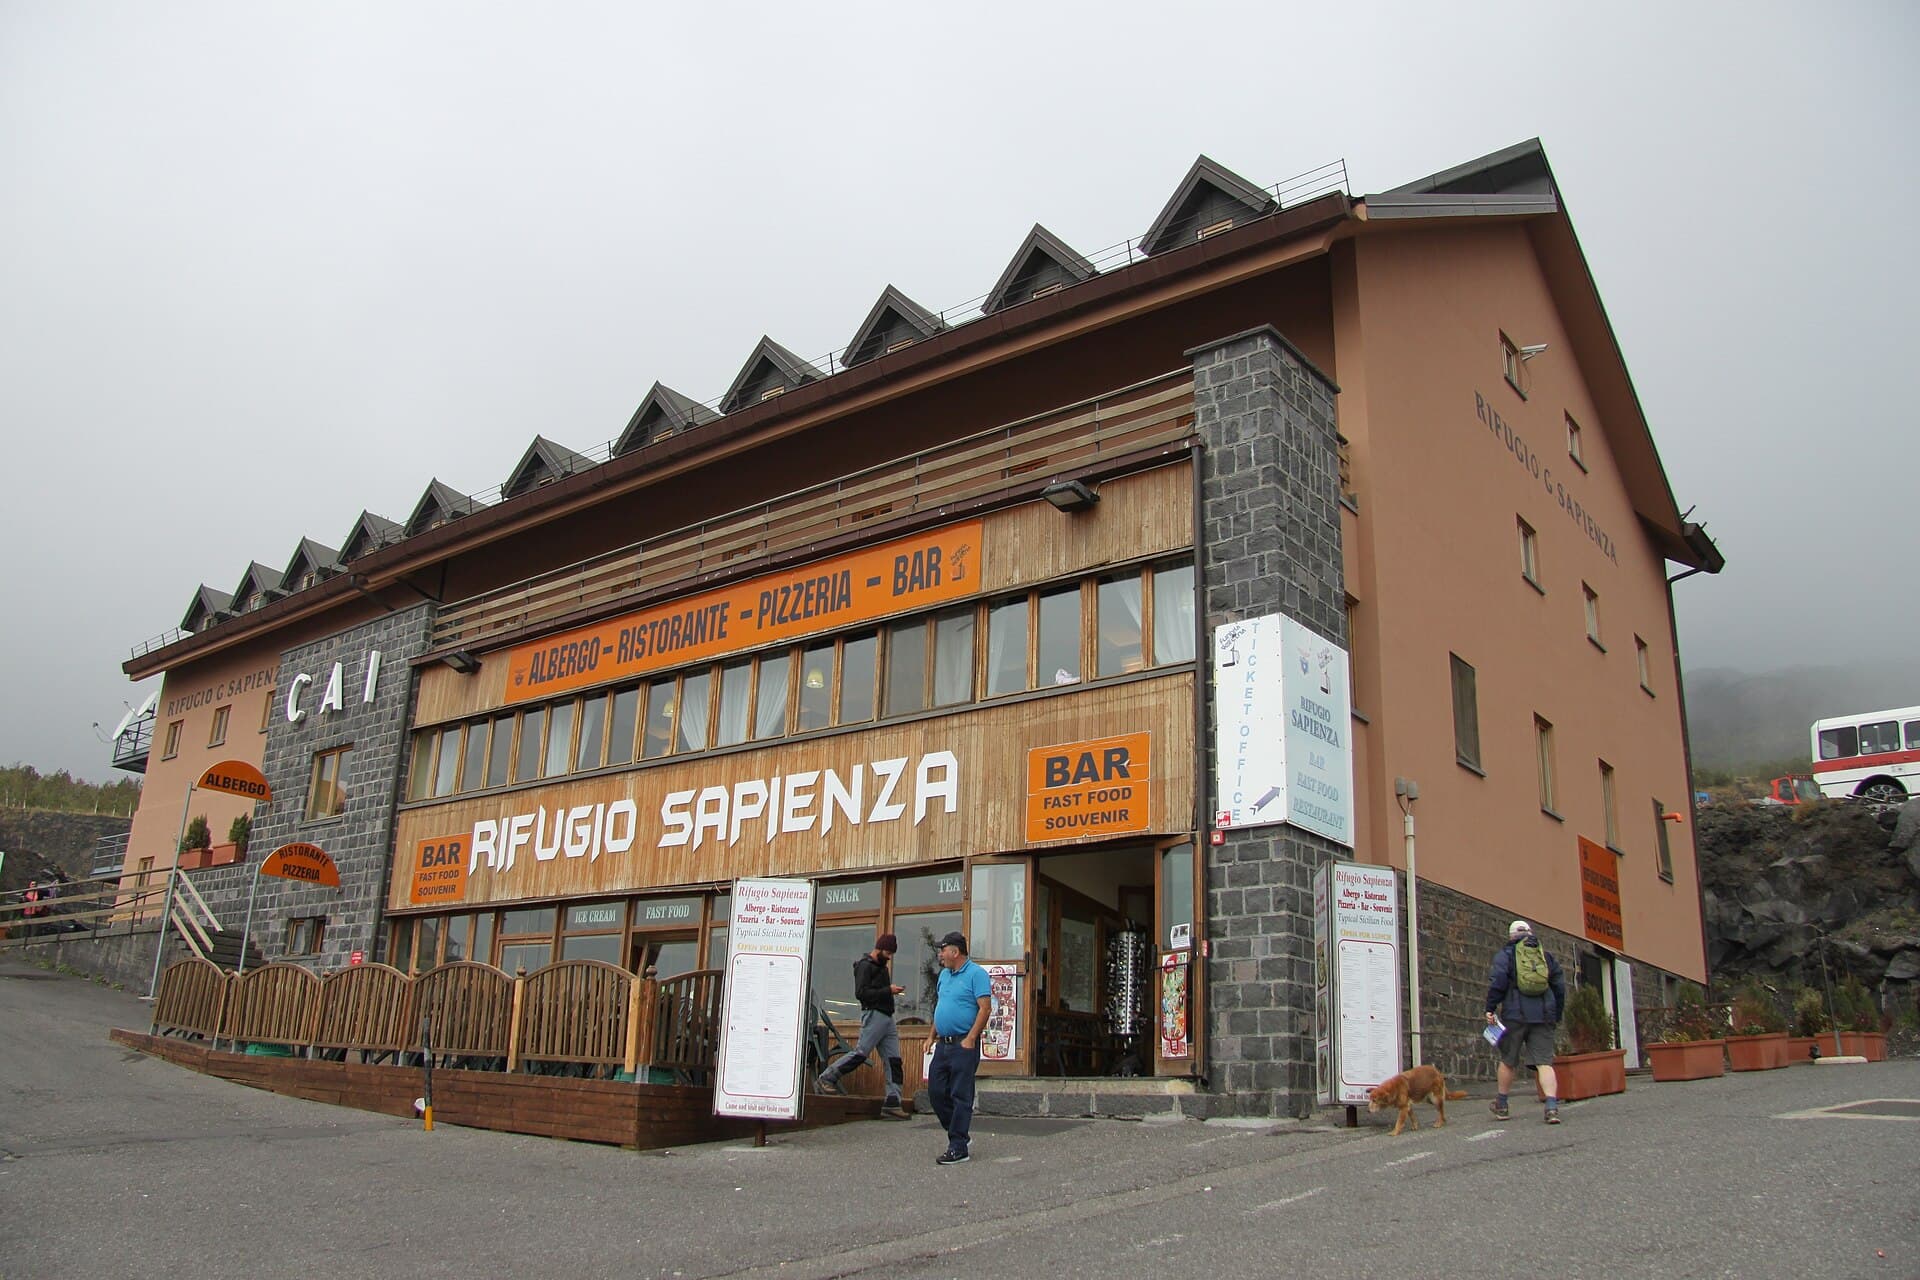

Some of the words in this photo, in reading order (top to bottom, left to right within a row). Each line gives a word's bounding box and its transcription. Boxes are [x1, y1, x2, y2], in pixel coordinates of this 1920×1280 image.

[1474, 389, 1539, 480] RIFUGIO
[1557, 482, 1619, 568] SAPIENZA
[528, 636, 601, 686] ALBERGO
[616, 601, 730, 665] RISTORANTE
[757, 569, 851, 630] PIZZERIA
[892, 546, 942, 597] BAR
[1243, 622, 1260, 716] TICKET
[167, 687, 212, 718] RIFUGIO
[1300, 695, 1331, 723] RIFUGIO
[1291, 709, 1340, 748] SAPIENZA
[1045, 747, 1130, 788] BAR
[1231, 725, 1250, 821] OFFICE
[205, 773, 266, 796] ALBERGO
[1317, 777, 1339, 802] FOOD
[1043, 793, 1082, 810] FAST
[1087, 787, 1132, 805] FOOD
[469, 799, 638, 877] RIFUGIO
[657, 750, 958, 853] SAPIENZA
[1045, 809, 1129, 830] SOUVENIR
[279, 845, 330, 867] RISTORANTE
[421, 842, 462, 868] BAR
[282, 863, 320, 881] PIZZERIA
[418, 871, 437, 882] FAST
[438, 869, 460, 880] FOOD
[1336, 871, 1361, 886] Rifugio
[1362, 874, 1393, 888] Sapienza
[418, 884, 456, 897] SOUVENIR
[738, 886, 769, 901] Rifugio
[770, 887, 808, 902] Sapienza
[937, 877, 961, 893] TEA
[1343, 888, 1360, 900] Albergo
[825, 888, 860, 904] SNACK
[1360, 902, 1369, 911] Bar
[575, 910, 588, 923] ICE
[588, 909, 616, 923] CREAM
[646, 906, 667, 919] FAST
[668, 904, 690, 918] FOOD
[744, 903, 766, 915] Albergo
[770, 904, 800, 914] Ristorante
[1010, 881, 1024, 946] BAR
[1338, 913, 1359, 925] Typical
[1380, 916, 1394, 926] Food
[737, 914, 759, 924] Pizzeria
[765, 915, 776, 924] Bar
[780, 915, 805, 926] Souvenir
[735, 927, 761, 939] Typical
[761, 928, 787, 938] Sicilian
[788, 929, 805, 939] Food
